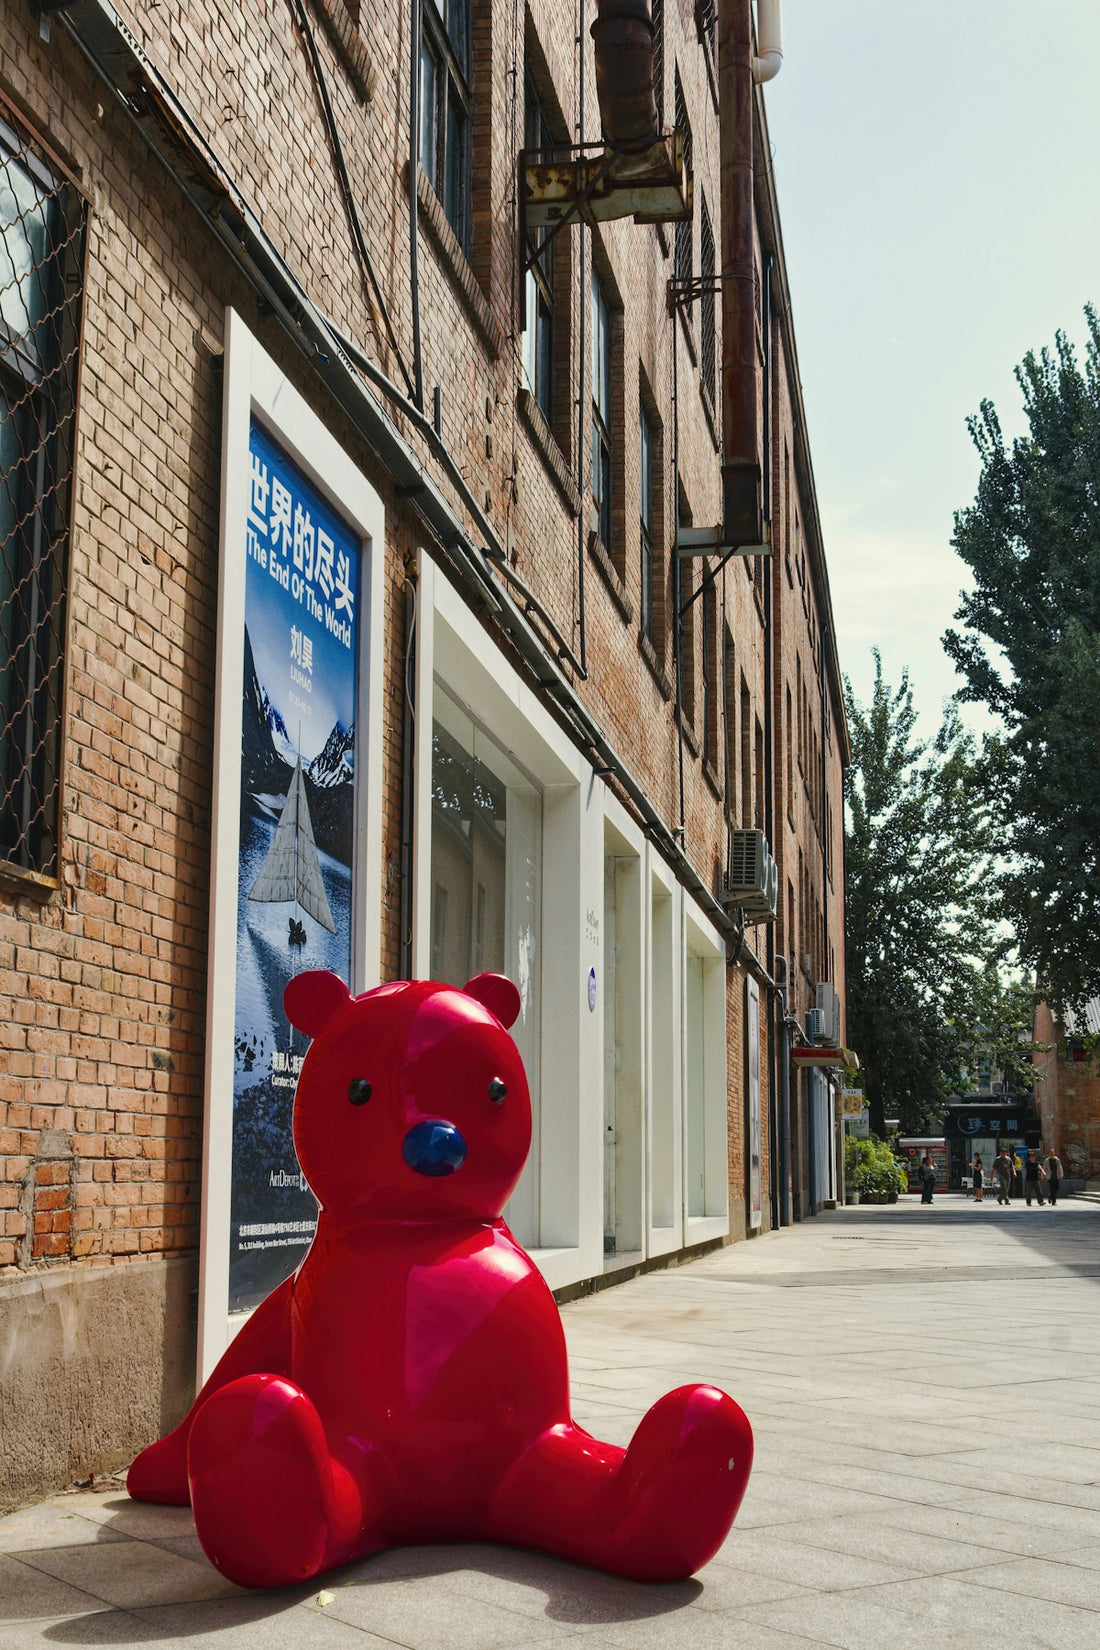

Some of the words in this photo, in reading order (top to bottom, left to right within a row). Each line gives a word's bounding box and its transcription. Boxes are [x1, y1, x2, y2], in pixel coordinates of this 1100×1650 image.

[247, 450, 354, 622] 世界的尽头
[247, 526, 267, 568] The
[269, 549, 289, 591] End
[291, 573, 304, 604] Of
[306, 584, 323, 622] The
[325, 603, 351, 649] World
[290, 624, 313, 676] 刘昊
